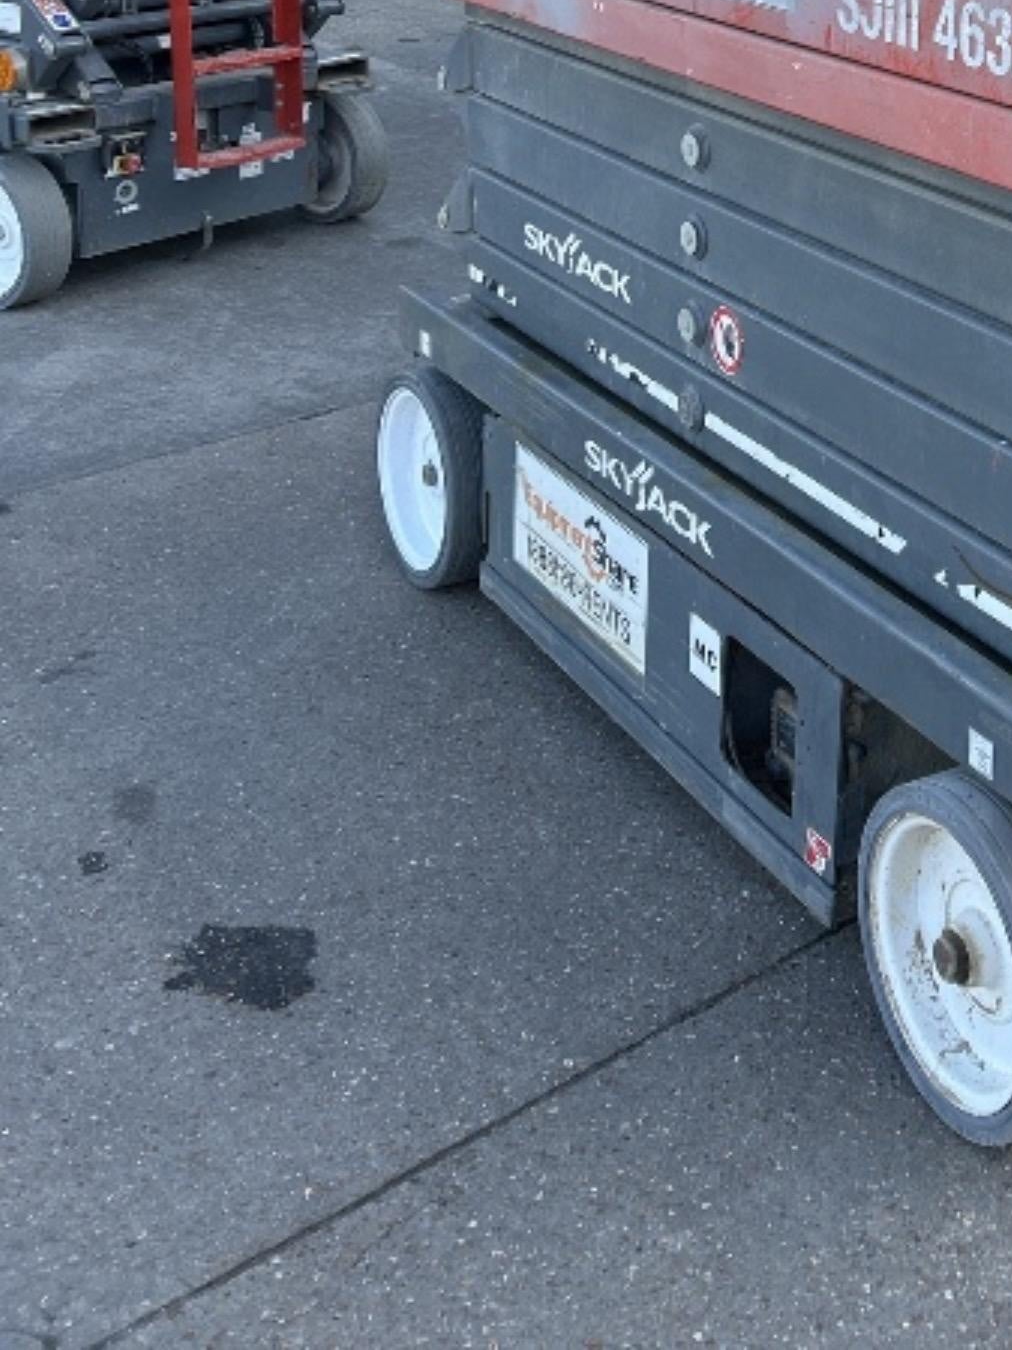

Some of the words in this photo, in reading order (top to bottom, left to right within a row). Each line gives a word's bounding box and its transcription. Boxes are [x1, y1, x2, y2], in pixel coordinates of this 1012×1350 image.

[524, 223, 631, 304] SKYJACK
[584, 440, 714, 559] SKYJACK
[694, 637, 718, 672] MC
